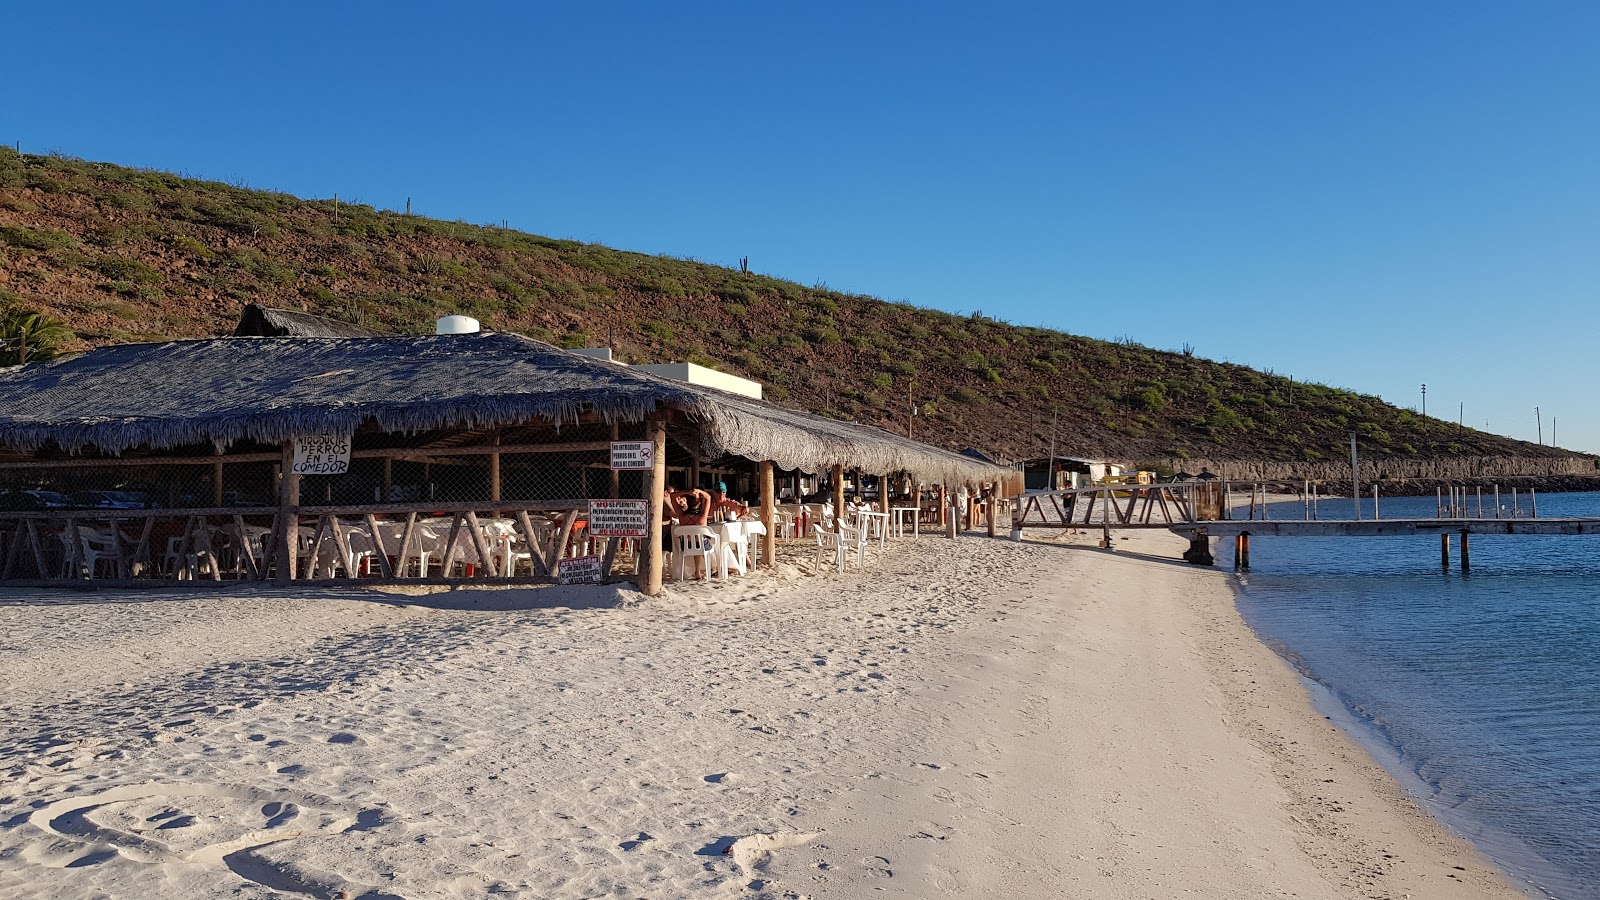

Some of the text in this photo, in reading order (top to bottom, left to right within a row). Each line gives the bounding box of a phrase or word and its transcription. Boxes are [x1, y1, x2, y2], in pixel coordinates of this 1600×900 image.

[302, 444, 348, 454] PERROS
[306, 454, 339, 463] EN EL
[294, 460, 347, 473] COMEDOR
